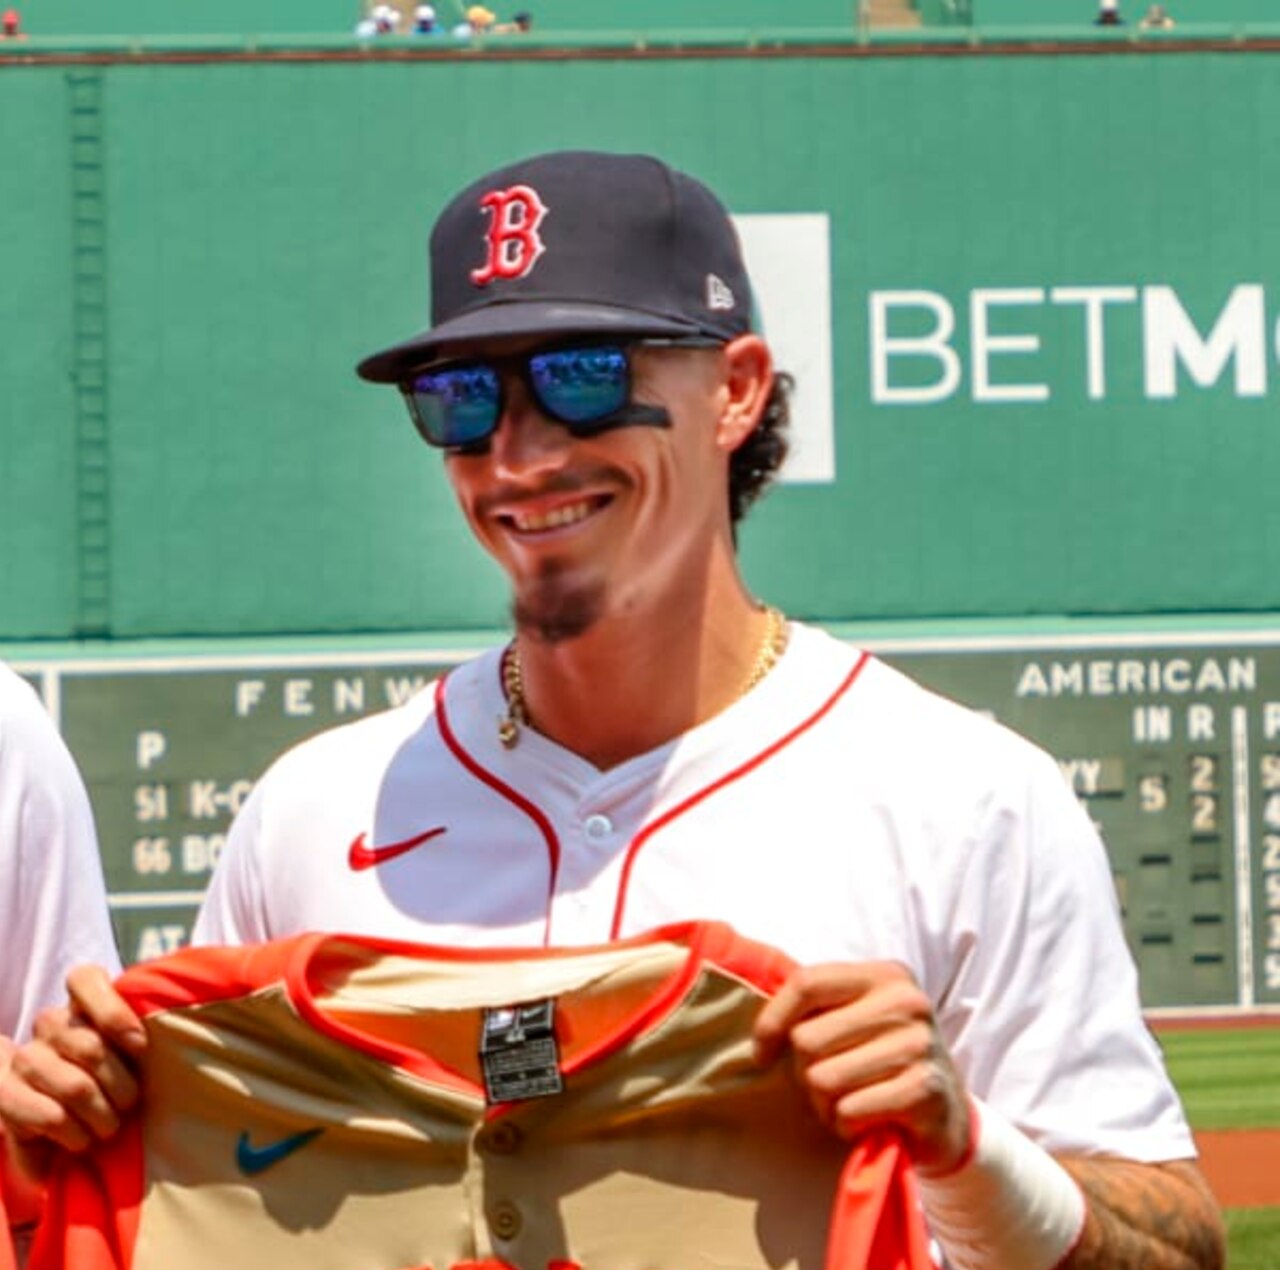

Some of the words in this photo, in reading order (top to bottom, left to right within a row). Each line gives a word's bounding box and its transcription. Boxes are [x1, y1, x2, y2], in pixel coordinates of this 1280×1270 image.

[471, 185, 548, 285] B
[869, 284, 1280, 403] BETM
[1015, 656, 1257, 698] AMERICAN
[1133, 704, 1172, 742] IN
[1187, 703, 1216, 740] R
[137, 731, 167, 768] P
[1190, 756, 1215, 791] 2
[1192, 796, 1217, 831] 2
